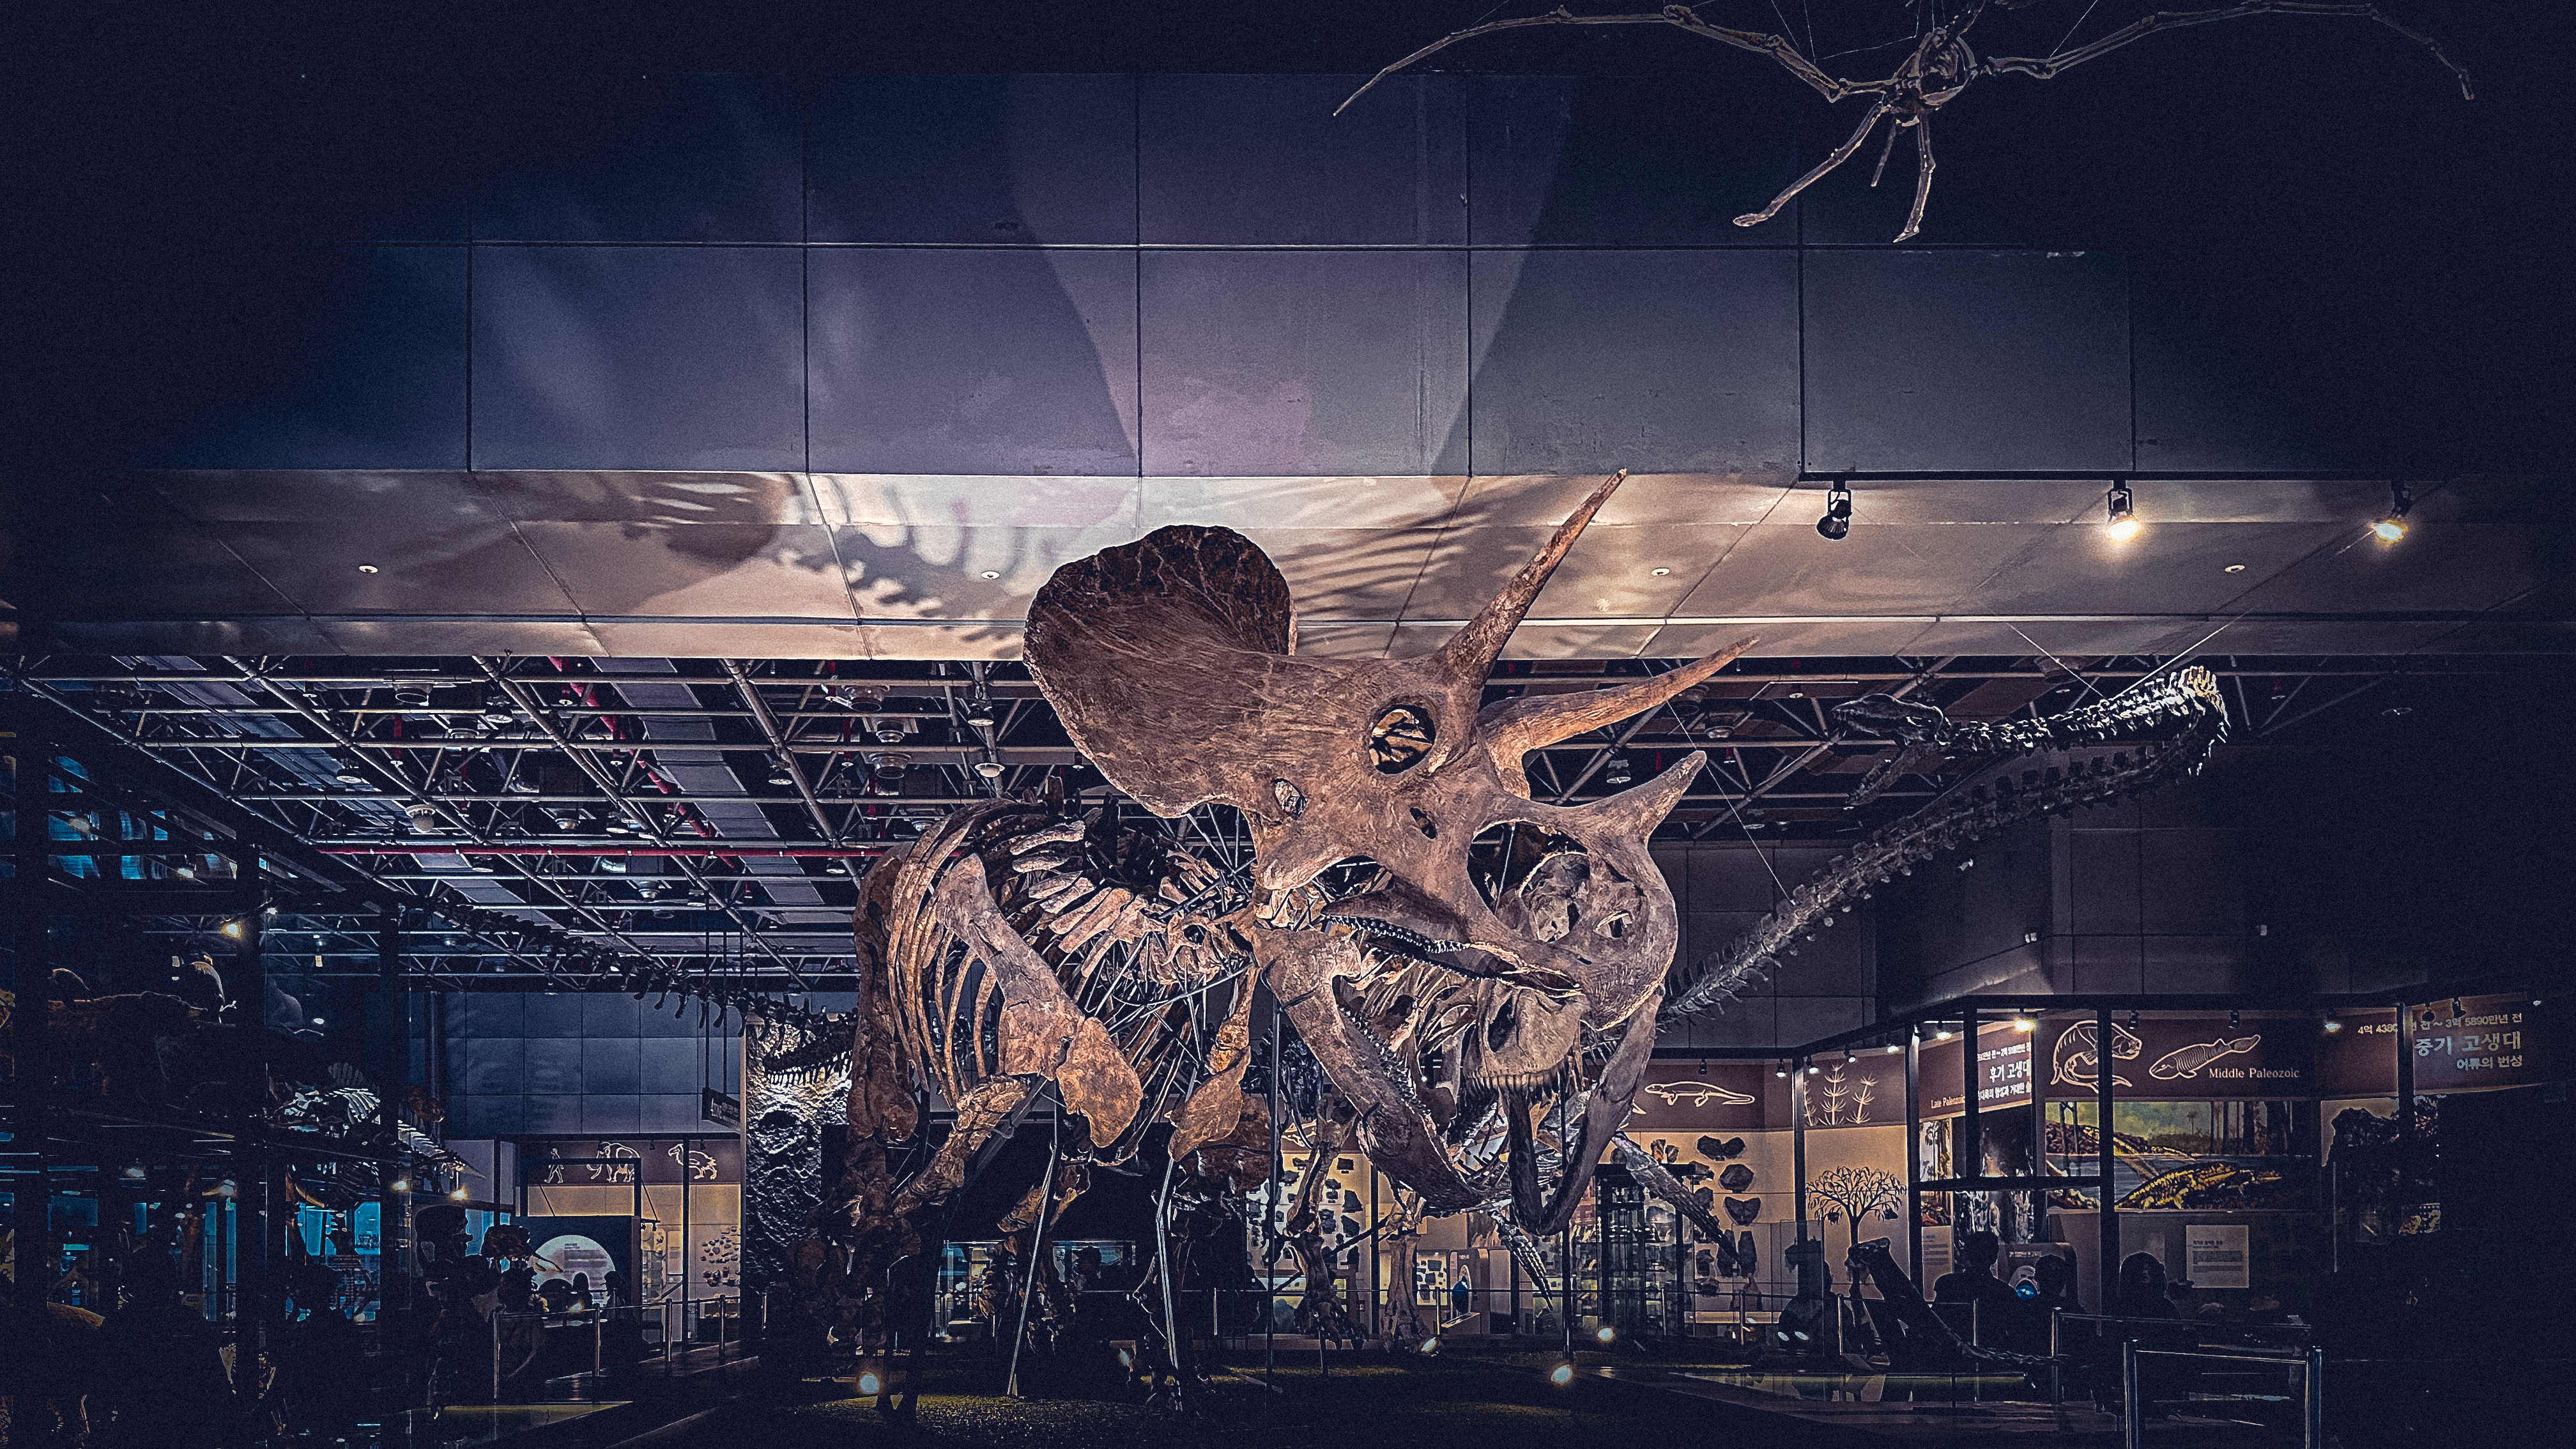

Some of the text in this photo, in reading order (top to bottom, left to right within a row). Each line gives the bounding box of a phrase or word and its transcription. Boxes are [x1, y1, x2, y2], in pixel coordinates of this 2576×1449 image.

[2358, 1025, 2373, 1034] 4억
[2445, 1017, 2461, 1028] 3억
[2511, 1013, 2522, 1023] 전
[2414, 1031, 2520, 1057] 중기 고생대
[2457, 1055, 2522, 1071] 어류의 번성
[1989, 1064, 2005, 1083] 후기
[2209, 1068, 2300, 1078] Middle Paleozoic
